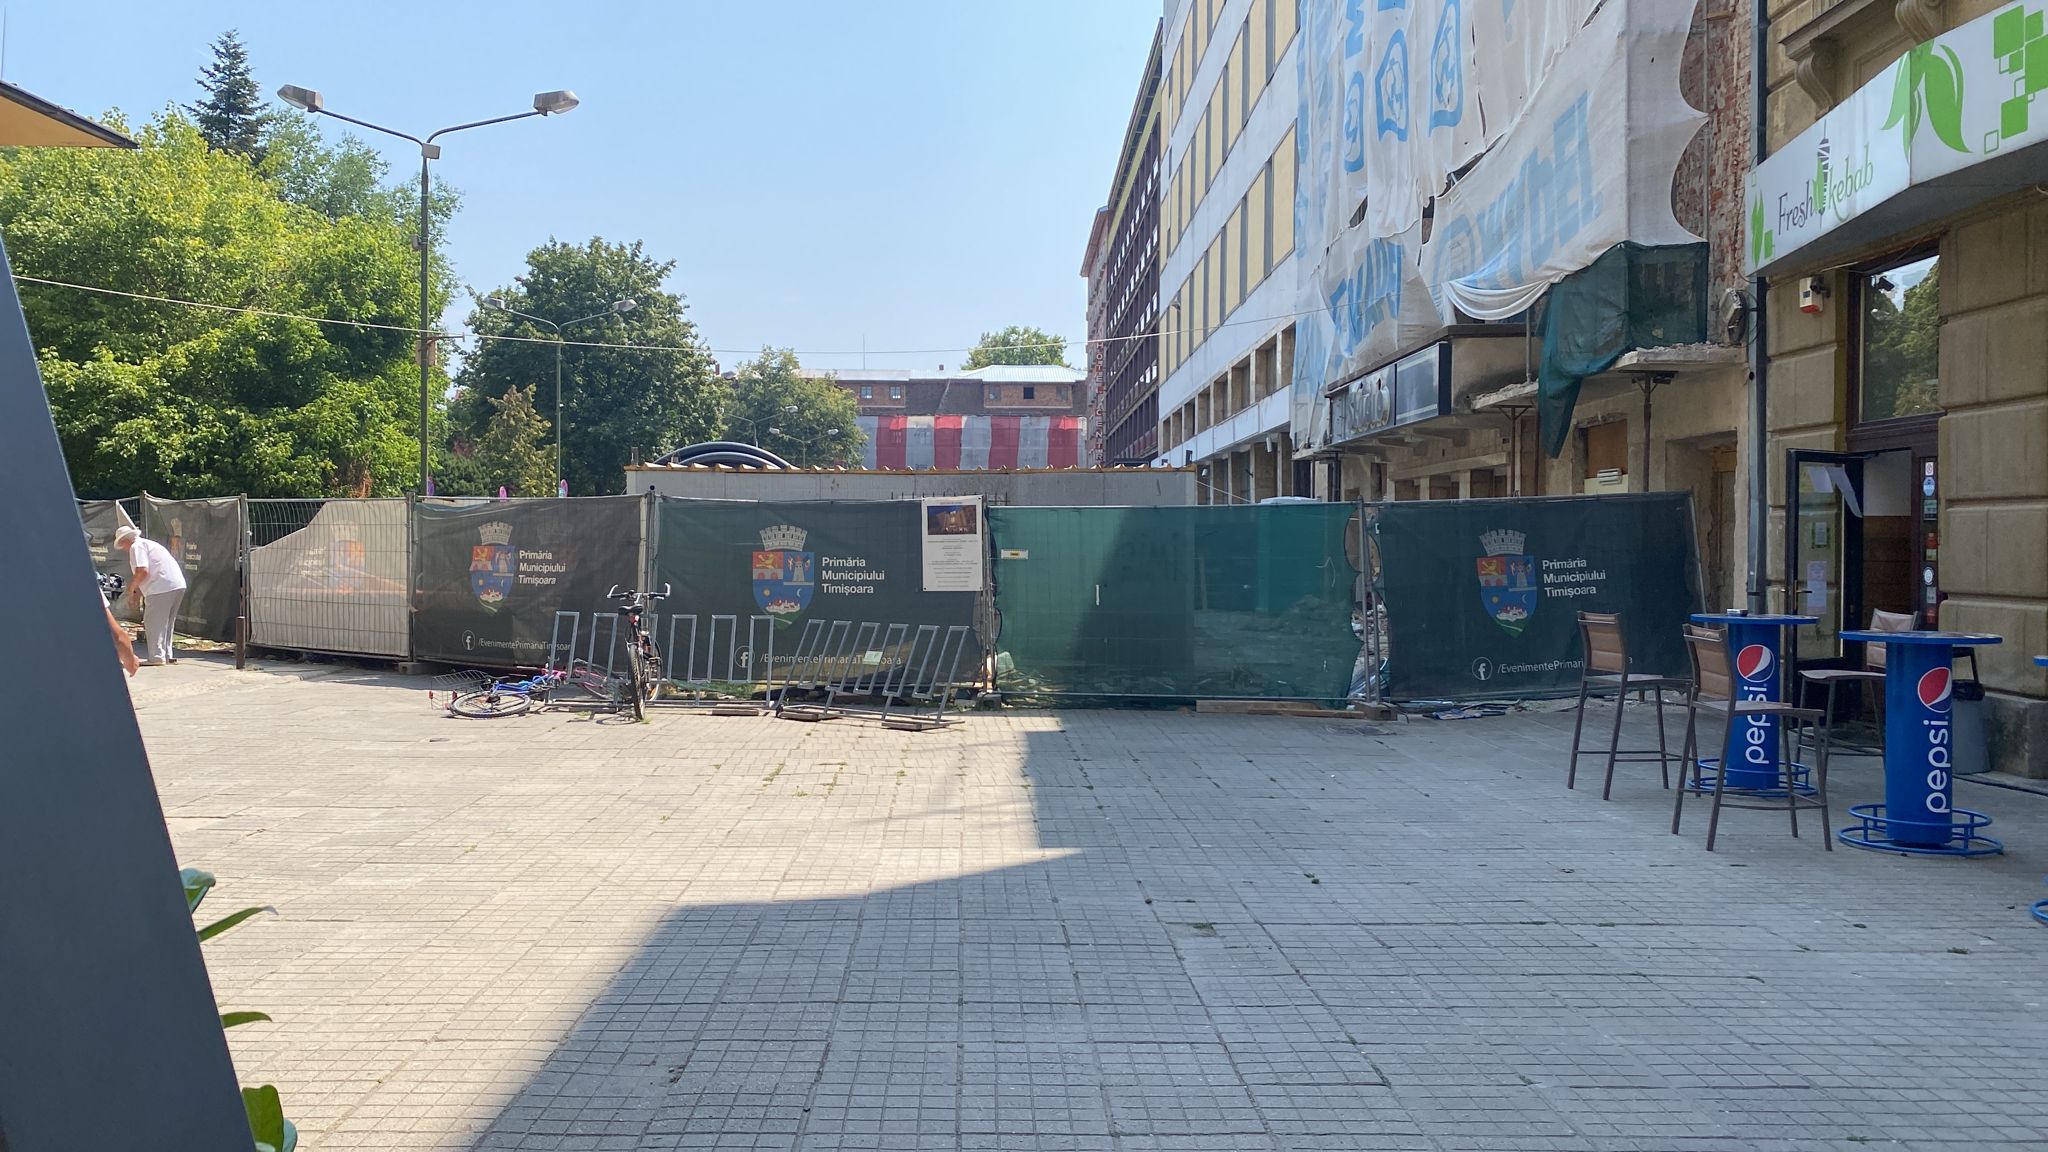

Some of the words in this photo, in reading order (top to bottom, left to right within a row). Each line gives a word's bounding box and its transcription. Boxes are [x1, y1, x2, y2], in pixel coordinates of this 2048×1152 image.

[1778, 180, 1813, 235] Fresh
[1828, 143, 1873, 221] kebab
[519, 550, 552, 560] Primăria
[822, 557, 866, 567] Primăria
[1542, 558, 1587, 570] Primăria
[519, 563, 566, 574] Municipiului
[518, 575, 556, 586] Timișoara
[822, 570, 885, 582] Municipiului
[1543, 570, 1606, 585] Municipiului
[822, 584, 874, 595] Timișoara
[1544, 586, 1597, 598] Timișoara
[1923, 719, 1951, 813] pepsi
